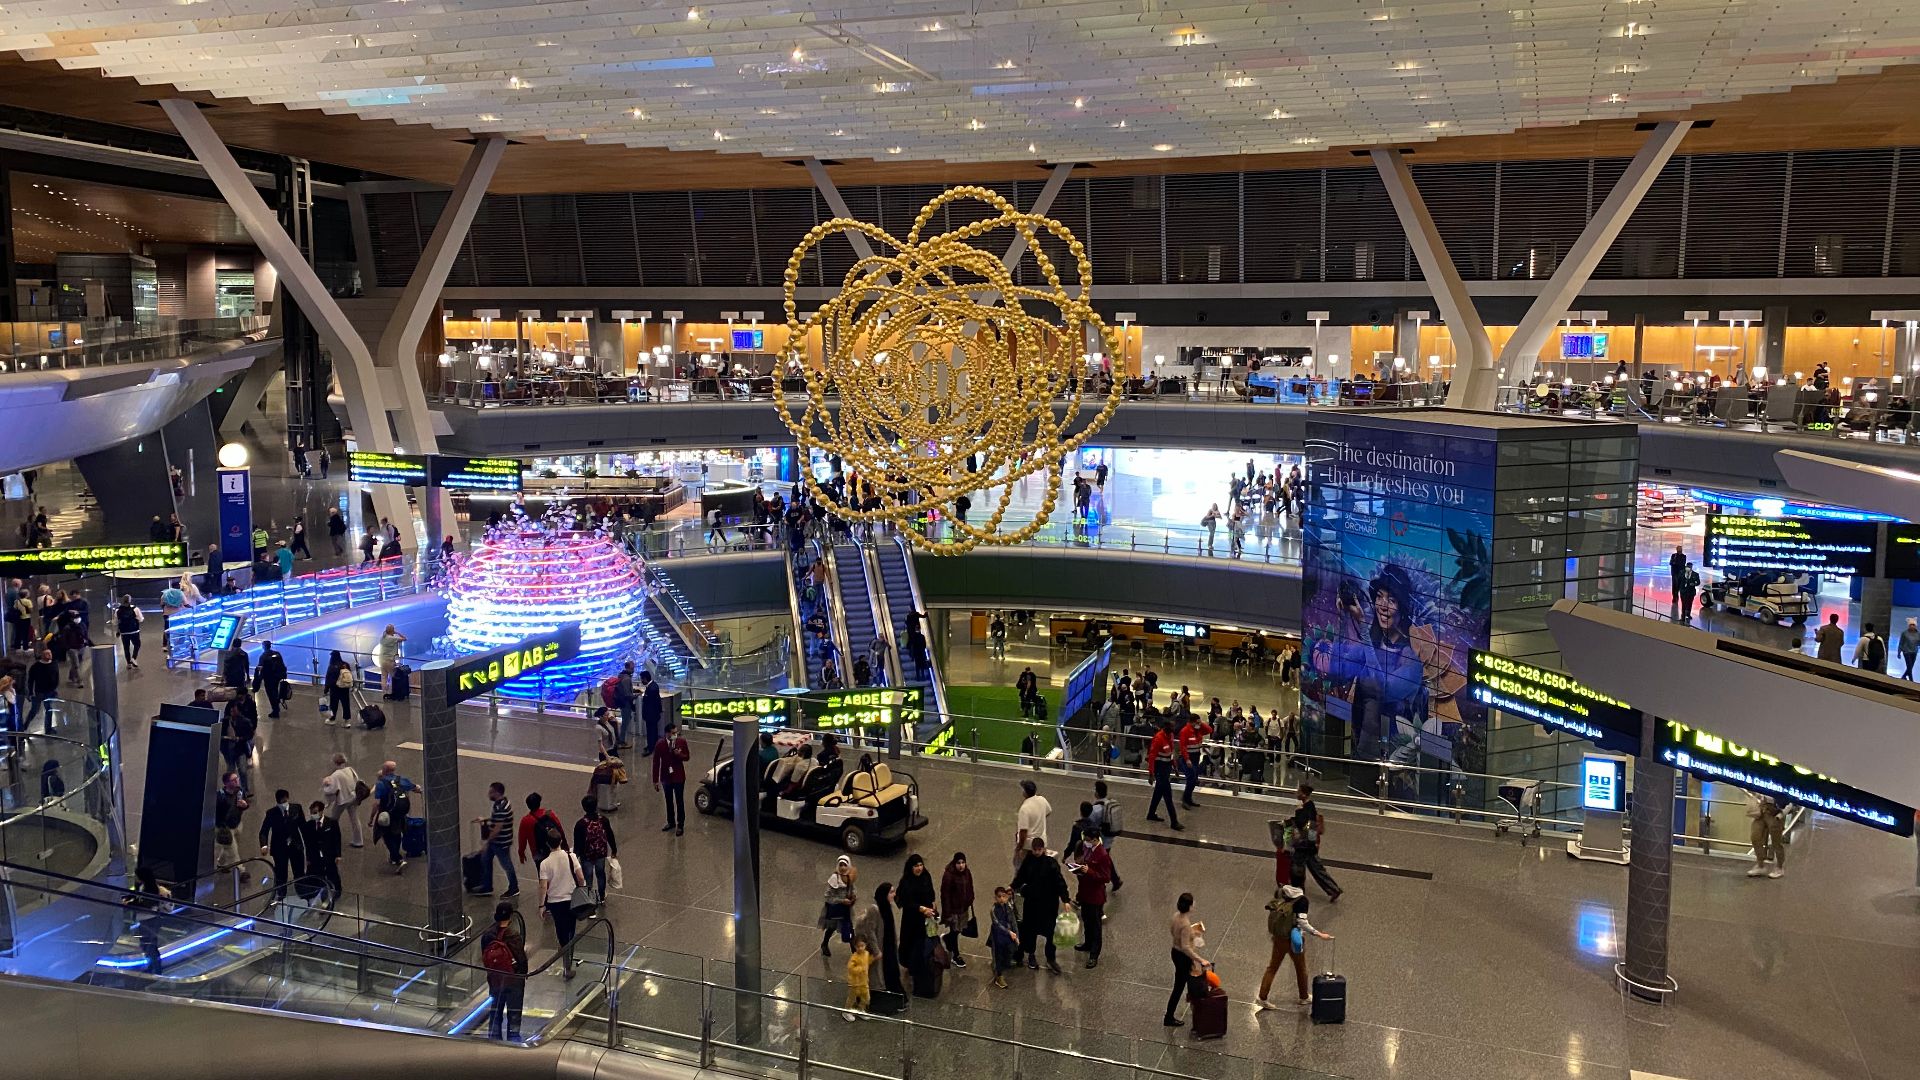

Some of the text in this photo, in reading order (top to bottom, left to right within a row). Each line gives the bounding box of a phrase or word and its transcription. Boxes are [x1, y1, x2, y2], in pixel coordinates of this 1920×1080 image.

[1337, 442, 1456, 477] The destination
[1328, 465, 1465, 505] that refreshes you
[1344, 521, 1378, 535] ORCHARD
[1734, 528, 1777, 538] C30-C43
[104, 557, 154, 570] C30-C43
[521, 646, 544, 670] AB
[843, 693, 880, 705] ABDE
[1499, 678, 1548, 704] C30-C43
[1504, 699, 1525, 713] Garden
[1524, 705, 1540, 718] Hotel
[1690, 758, 1723, 775] Lounges
[1723, 766, 1745, 782] North
[1745, 774, 1752, 784] &
[1753, 777, 1783, 793] Garden
[1788, 787, 1824, 807] والحديقة
[1824, 796, 1851, 814] شمال
[1857, 807, 1895, 827] الصالات
